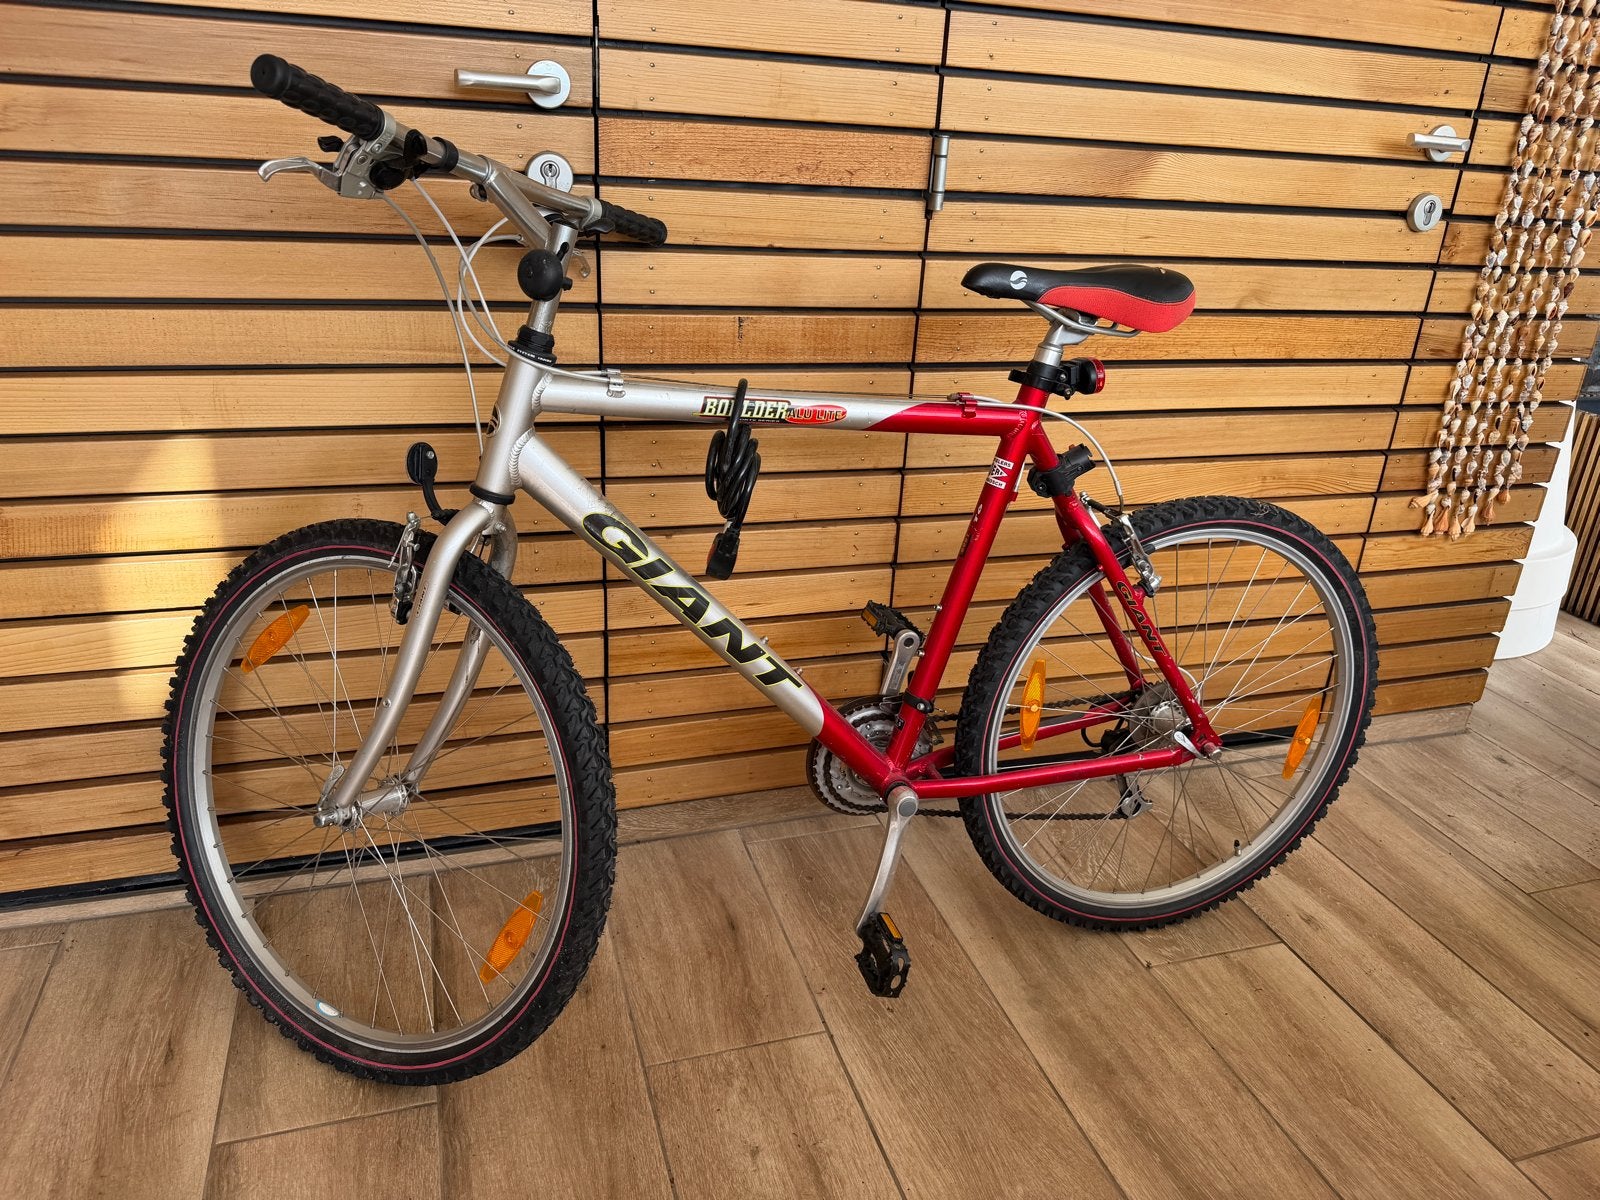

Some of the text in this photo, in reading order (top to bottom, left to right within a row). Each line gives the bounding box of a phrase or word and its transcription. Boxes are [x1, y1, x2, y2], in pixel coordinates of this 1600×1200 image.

[787, 408, 842, 421] ALU LITE
[583, 513, 803, 690] GIANT
[1116, 581, 1167, 656] GIANT
